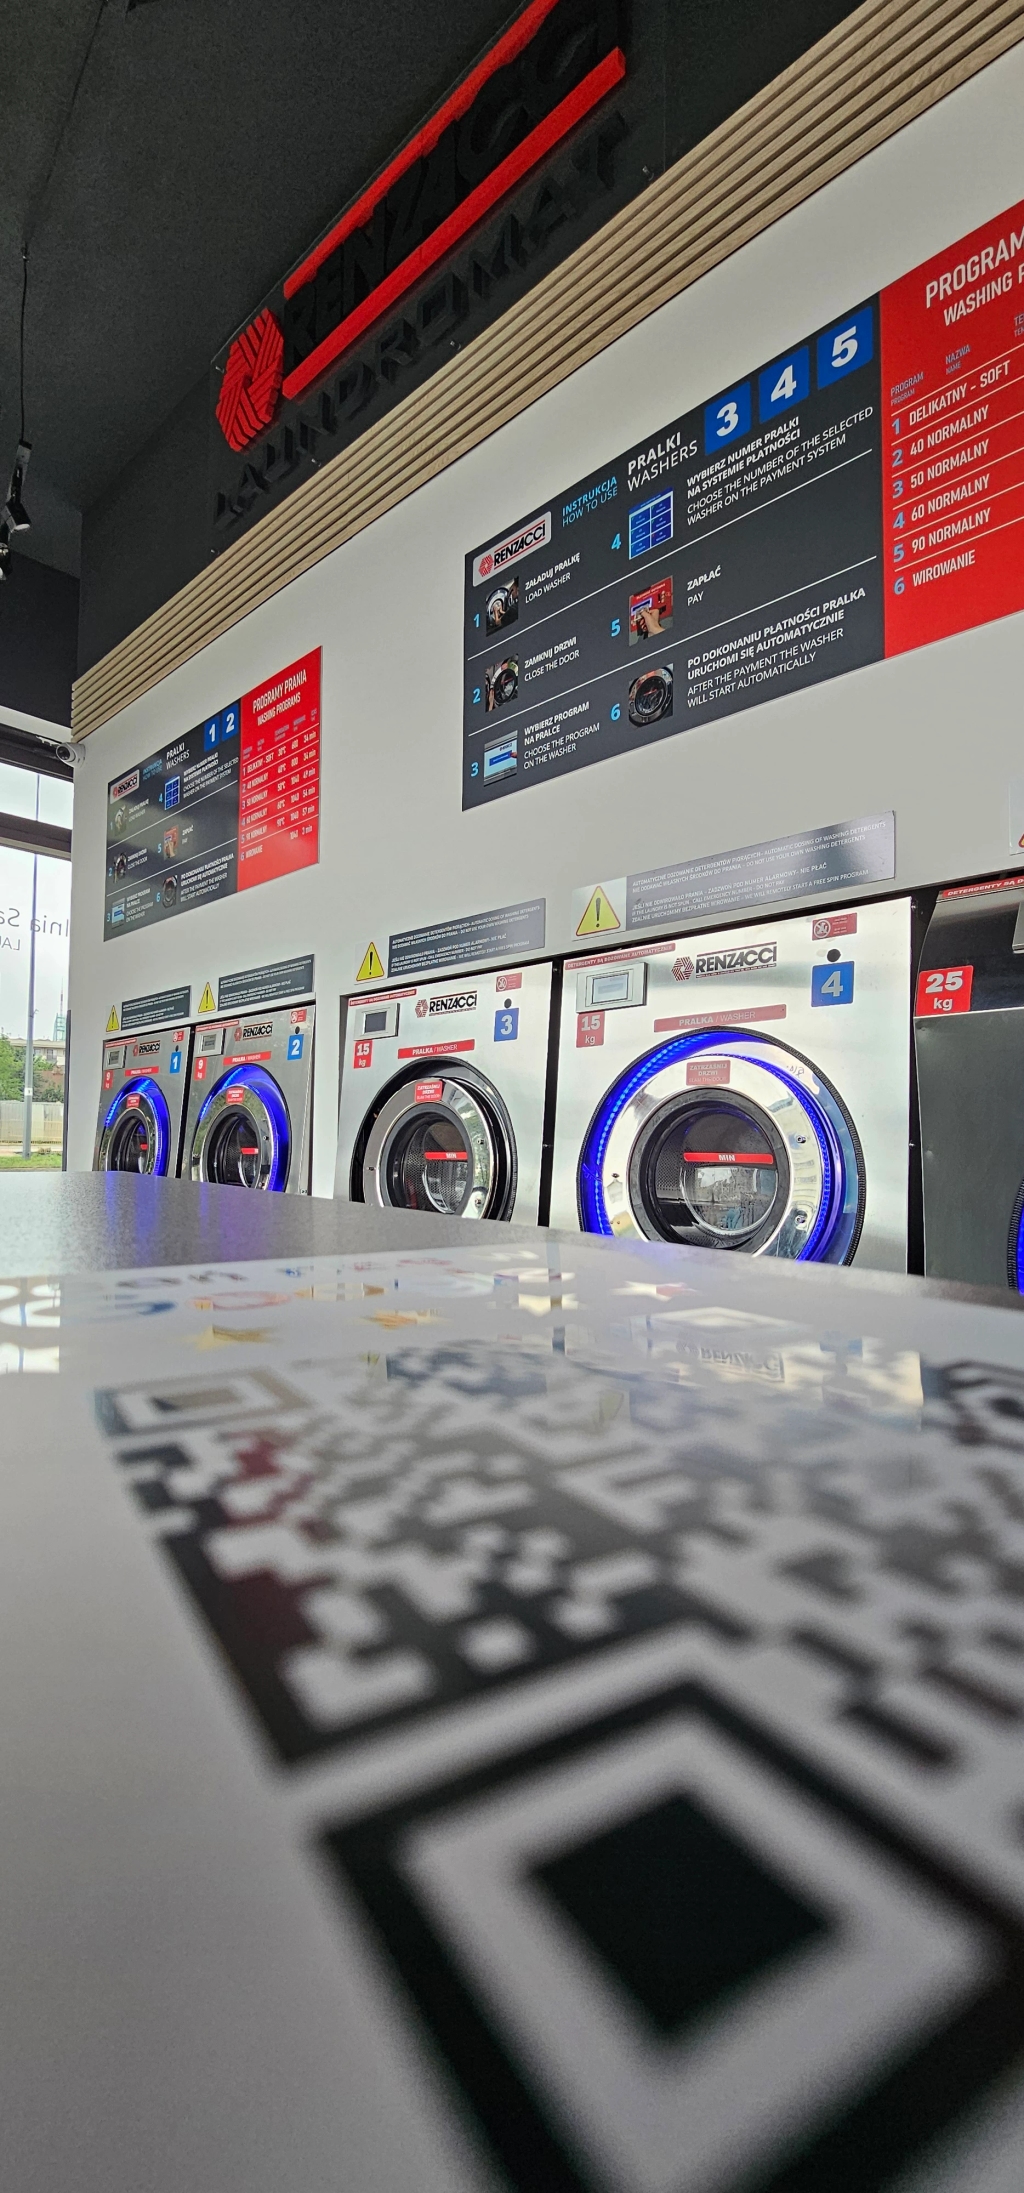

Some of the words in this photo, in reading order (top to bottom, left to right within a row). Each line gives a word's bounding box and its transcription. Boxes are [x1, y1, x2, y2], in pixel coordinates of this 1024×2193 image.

[944, 271, 1013, 326] WASHING
[831, 326, 858, 368] 5
[946, 344, 970, 365] NAZWA
[946, 361, 961, 375] NAME
[771, 365, 796, 402] 4
[890, 372, 924, 396] PROGRAM
[891, 388, 915, 406] PROGRAM
[892, 418, 900, 435] 1
[909, 383, 968, 426] DELIKATNY
[980, 360, 1010, 388] SOFT
[716, 402, 738, 437] 3
[892, 449, 903, 468] 2
[910, 438, 924, 456] 40
[927, 405, 989, 448] NORMALNY
[628, 431, 681, 475] PRALKI
[687, 458, 726, 487] WYBIERZ
[728, 438, 762, 464] NUMER
[765, 416, 799, 444] PRALKI
[688, 490, 723, 514] CHOOSE
[725, 479, 742, 497] THE
[744, 456, 784, 487] NUMBER
[786, 446, 799, 461] OF
[801, 435, 820, 454] THE
[822, 406, 873, 441] SELECTED
[688, 483, 701, 499] NA
[702, 461, 745, 491] SYSTEMIE
[747, 429, 800, 467] PŁATNOŚCI
[627, 440, 698, 492] WASHERS
[892, 480, 903, 499] 3
[910, 471, 924, 489] 50
[927, 439, 989, 482] NORMALNY
[688, 502, 723, 526] WASHER
[725, 492, 738, 506] ON
[740, 483, 758, 499] THE
[760, 459, 805, 488] PAYMENT
[807, 434, 846, 463] SYSTEM
[562, 476, 617, 516] INSTRUKCJA
[562, 507, 583, 527] HOW
[586, 499, 598, 512] TO
[601, 486, 617, 503] USE
[893, 512, 905, 529] 4
[911, 504, 924, 521] 60
[928, 473, 990, 515] NORMALNY
[494, 524, 546, 566] RENZACCI
[611, 534, 621, 550] 4
[894, 544, 904, 562] 5
[912, 536, 925, 554] 90
[928, 508, 990, 547] NORMALNY
[525, 565, 553, 590] ZAŁADUJ
[555, 553, 580, 574] PRALKĘ
[687, 565, 722, 591] ZAPŁAĆ
[894, 577, 905, 595] 6
[912, 550, 975, 587] WIROWANIE
[525, 586, 542, 604] LOAD
[544, 572, 570, 594] WASHER
[687, 591, 704, 606] PAY
[474, 613, 480, 627] 1
[611, 619, 620, 637] 5
[688, 655, 700, 668] PO
[702, 630, 762, 663] DOKONANIU
[764, 607, 820, 637] PŁATNOŚCI
[823, 587, 866, 613] PRALKA
[524, 645, 552, 668] ZAMKNIJ
[554, 636, 576, 654] DRZWI
[687, 653, 738, 680] URUCHOMI
[740, 646, 754, 660] SIĘ
[757, 610, 844, 653] AUTOMATYCZNIE
[525, 665, 544, 682] CLOSE
[545, 659, 558, 673] THE
[559, 650, 580, 667] DOOR
[688, 679, 713, 696] AFTER
[715, 672, 731, 685] THE
[734, 655, 777, 680] PAYMENT
[780, 646, 798, 661] THE
[800, 628, 844, 654] WASHER
[253, 682, 283, 714] PROGRAMY
[284, 669, 307, 694] PRANIA
[688, 692, 707, 708] WILL
[710, 683, 735, 700] START
[738, 652, 816, 690] AUTOMATICALLY
[473, 688, 480, 703] 2
[258, 707, 276, 726] WASHING
[276, 692, 301, 715] PROGRAMS
[524, 716, 553, 735] WYBIERZ
[554, 702, 589, 723] PROGRAM
[610, 703, 620, 721] 6
[209, 724, 215, 742] 1
[226, 713, 234, 733] 2
[524, 735, 534, 746] NA
[536, 724, 560, 741] PRALCE
[167, 742, 184, 760] PRALKI
[524, 741, 550, 759] CHOOSE
[551, 736, 564, 749] THE
[565, 722, 600, 744] PROGRAM
[166, 750, 189, 770] WASHERS
[524, 758, 534, 769] ON
[536, 753, 547, 766] THE
[548, 743, 576, 761] WASHER
[471, 762, 478, 777] 3
[831, 835, 865, 847] DETERGENTS
[850, 822, 886, 835] DETERGENTS
[948, 883, 1002, 896] DETERGENTY
[696, 946, 777, 973] RENZACCI
[821, 970, 843, 997] 4
[926, 970, 963, 994] 25
[429, 994, 477, 1012] RENZACCI
[933, 997, 953, 1011] kg
[243, 1024, 272, 1038] RENZACCI
[500, 1014, 513, 1035] 3
[581, 1016, 600, 1031] 15
[679, 1016, 713, 1026] PRALKA
[720, 1011, 756, 1022] WASHER
[291, 1039, 300, 1055] 2
[357, 1043, 369, 1055] 15
[585, 1035, 595, 1044] kg
[173, 1056, 178, 1070] 1
[198, 1060, 203, 1069] 9
